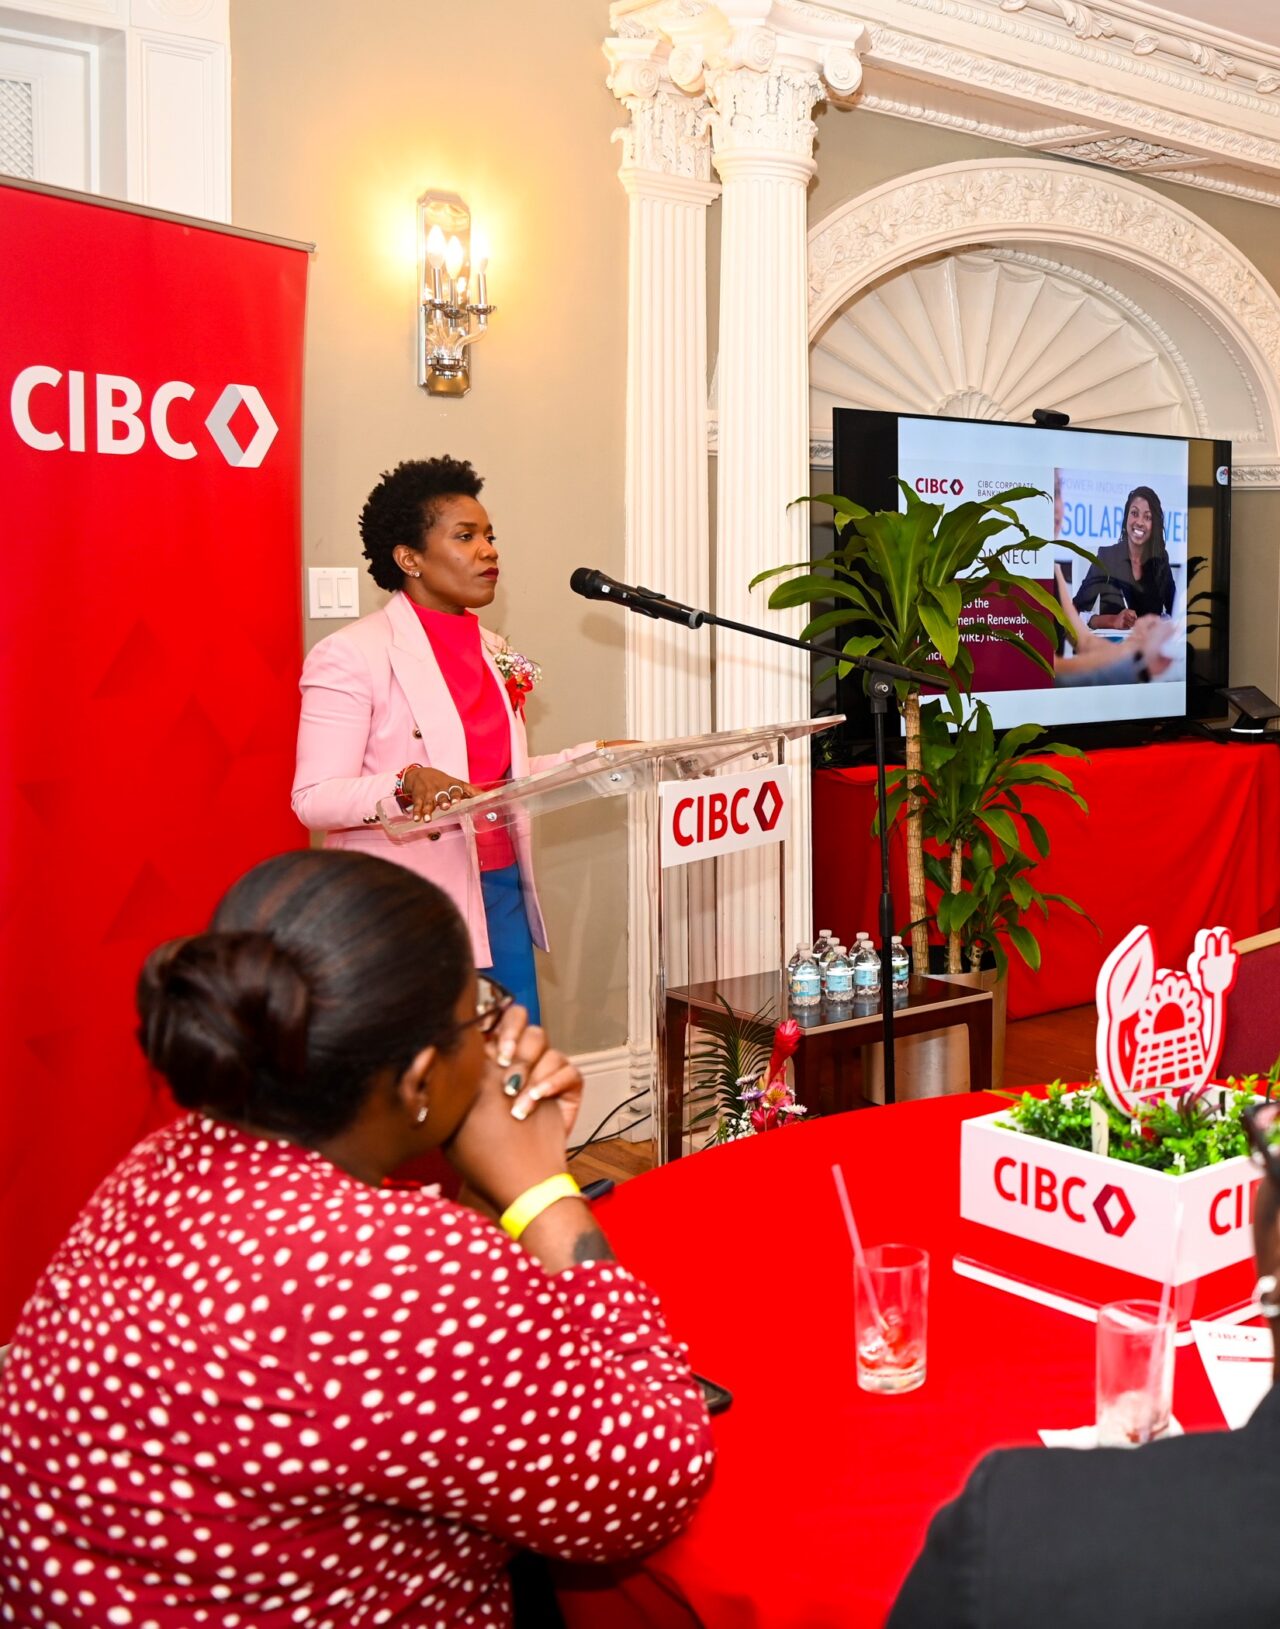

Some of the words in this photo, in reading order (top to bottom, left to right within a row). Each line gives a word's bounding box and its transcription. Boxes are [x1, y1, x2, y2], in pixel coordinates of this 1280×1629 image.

[10, 365, 198, 460] CIBC
[915, 477, 949, 495] CIBC
[977, 480, 993, 489] CIBC
[1061, 502, 1124, 539] SOLAR
[974, 598, 989, 608] the
[977, 614, 985, 623] in
[672, 787, 750, 847] CIBC
[994, 1156, 1087, 1223] CIBC
[1209, 1177, 1264, 1236] CI
